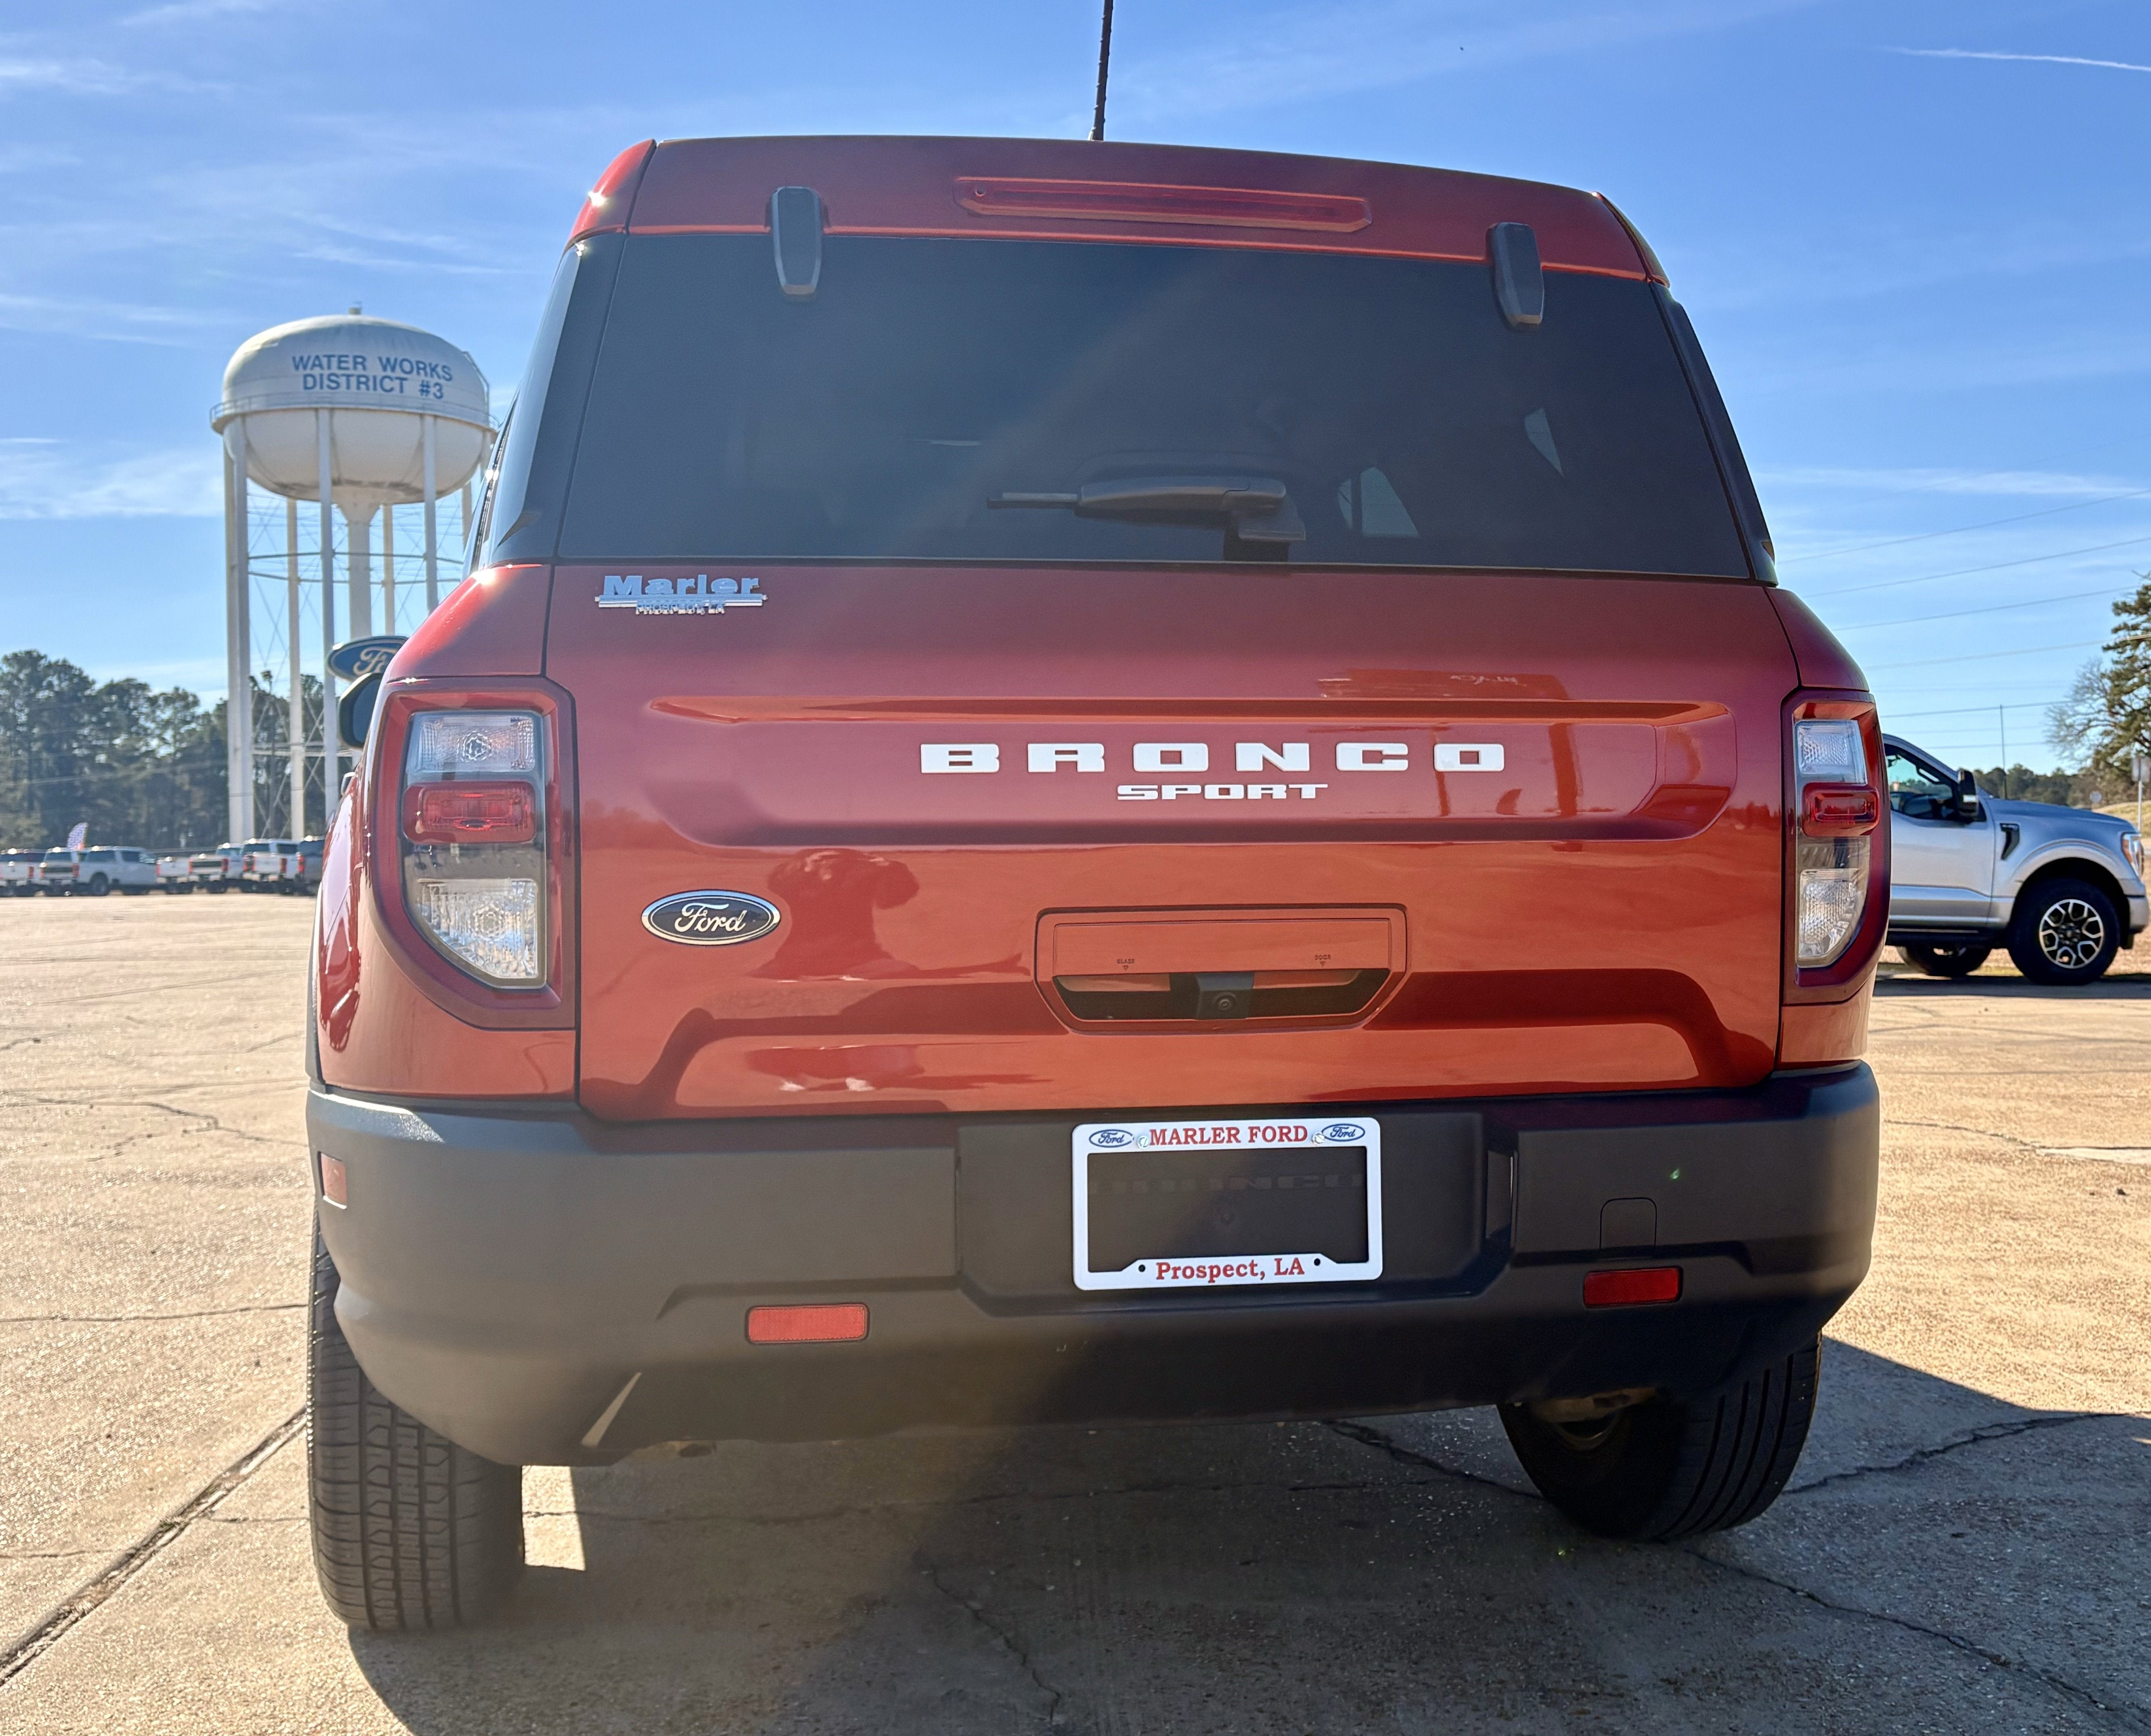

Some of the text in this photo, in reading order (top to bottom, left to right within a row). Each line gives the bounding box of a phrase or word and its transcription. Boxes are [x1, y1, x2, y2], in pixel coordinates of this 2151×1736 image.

[292, 354, 453, 382] WATER WORKS
[303, 373, 444, 400] DISTRICT #3
[604, 574, 759, 595] Marler
[921, 743, 1504, 772] BRONCO
[1117, 783, 1328, 800] SPORT
[674, 902, 748, 932] Ford
[1098, 1132, 1124, 1144] Ford
[1149, 1126, 1308, 1146] MARLER FORD
[1330, 1127, 1356, 1138] Ford
[1156, 1257, 1305, 1283] Prospect, LA
